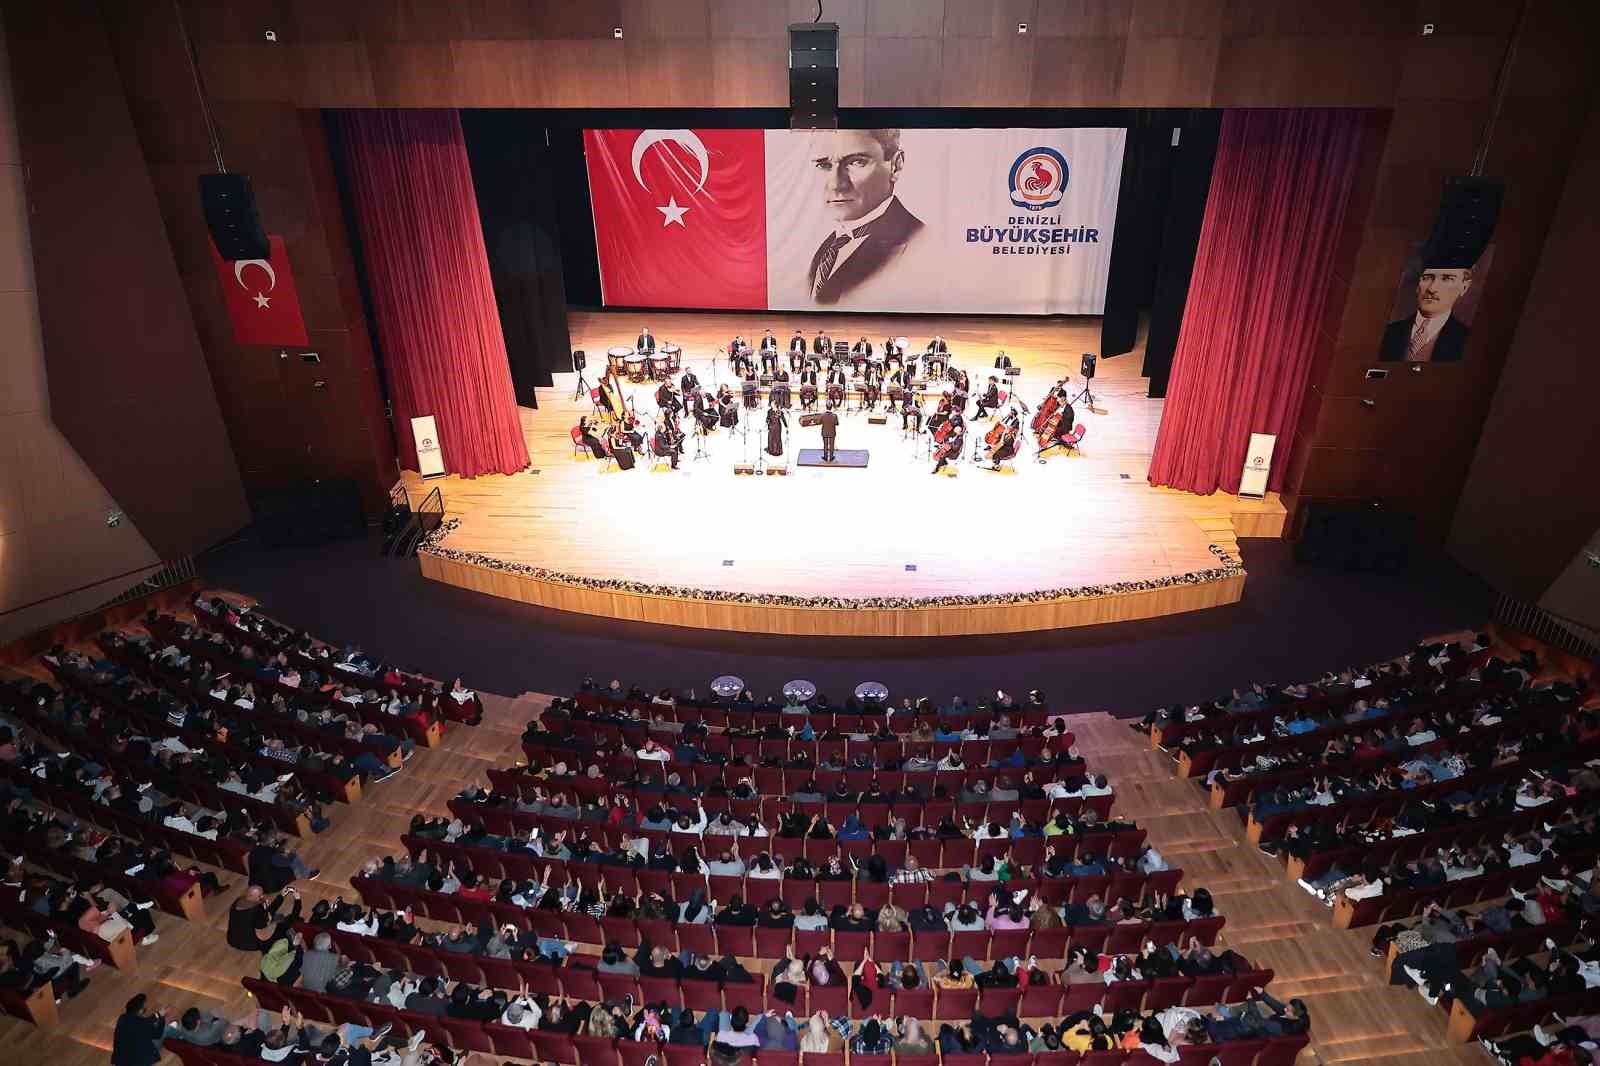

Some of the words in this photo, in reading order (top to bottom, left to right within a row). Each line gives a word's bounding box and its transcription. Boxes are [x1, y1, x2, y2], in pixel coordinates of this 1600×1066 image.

[1008, 215, 1061, 225] DENİZLİ
[966, 225, 1099, 244] BÜYÜKŞEHİR
[992, 245, 1071, 254] BELEDİYESİ
